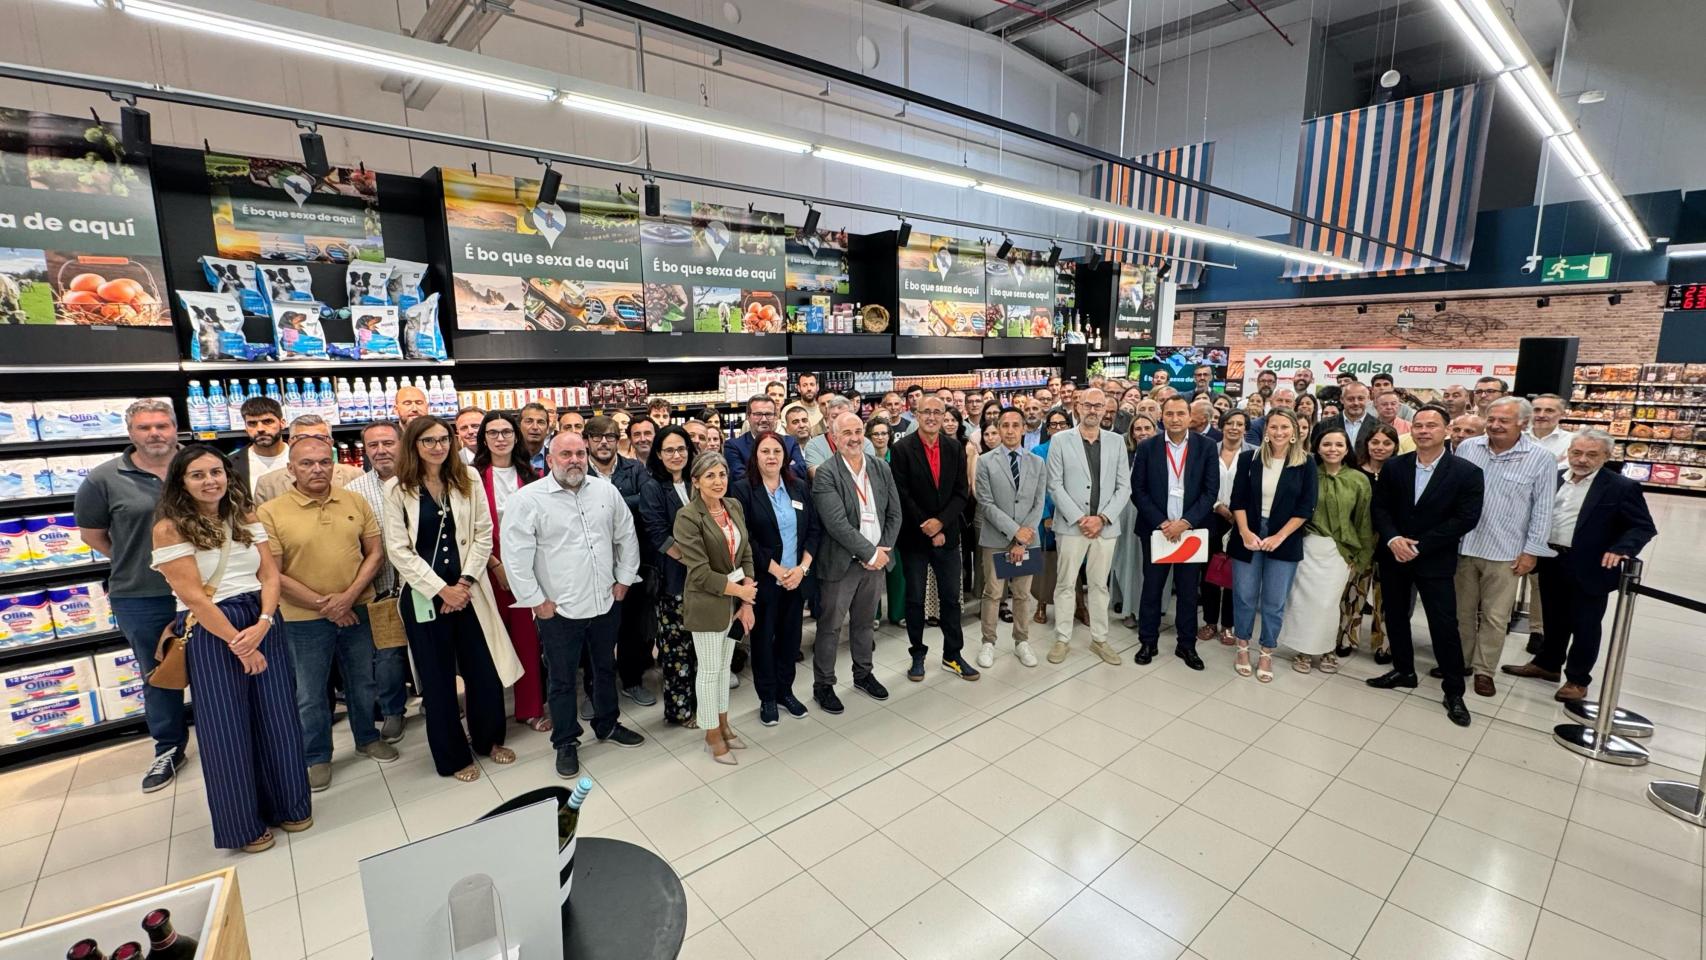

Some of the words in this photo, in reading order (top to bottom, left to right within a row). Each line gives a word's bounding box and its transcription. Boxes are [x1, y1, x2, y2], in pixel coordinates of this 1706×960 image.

[242, 204, 249, 215] É
[250, 207, 265, 216] bo
[267, 210, 289, 219] que
[291, 212, 316, 220] sexa
[317, 213, 331, 222] de
[332, 215, 356, 225] aquí
[23, 212, 63, 231] de
[69, 218, 135, 240] aquí
[464, 243, 474, 260] É
[478, 247, 499, 261] bo
[502, 252, 533, 267] que
[536, 256, 572, 267] sexa
[575, 255, 594, 268] de
[596, 258, 629, 273] aquí
[653, 256, 660, 271] É
[663, 261, 679, 272] bo
[680, 265, 704, 277] que
[706, 266, 732, 277] sexa
[734, 267, 749, 278] de
[751, 268, 777, 282] aquí
[904, 279, 910, 290] É
[910, 281, 920, 290] bo
[920, 284, 934, 294] que
[935, 285, 952, 293] sexa
[953, 285, 962, 294] de
[962, 286, 979, 296] aquí
[994, 288, 1002, 296] bo
[1002, 290, 1013, 298] que
[1027, 291, 1035, 299] de
[1035, 290, 1049, 301] aquí
[1254, 355, 1311, 371] Vegalsa
[1323, 357, 1392, 374] Vegalsa
